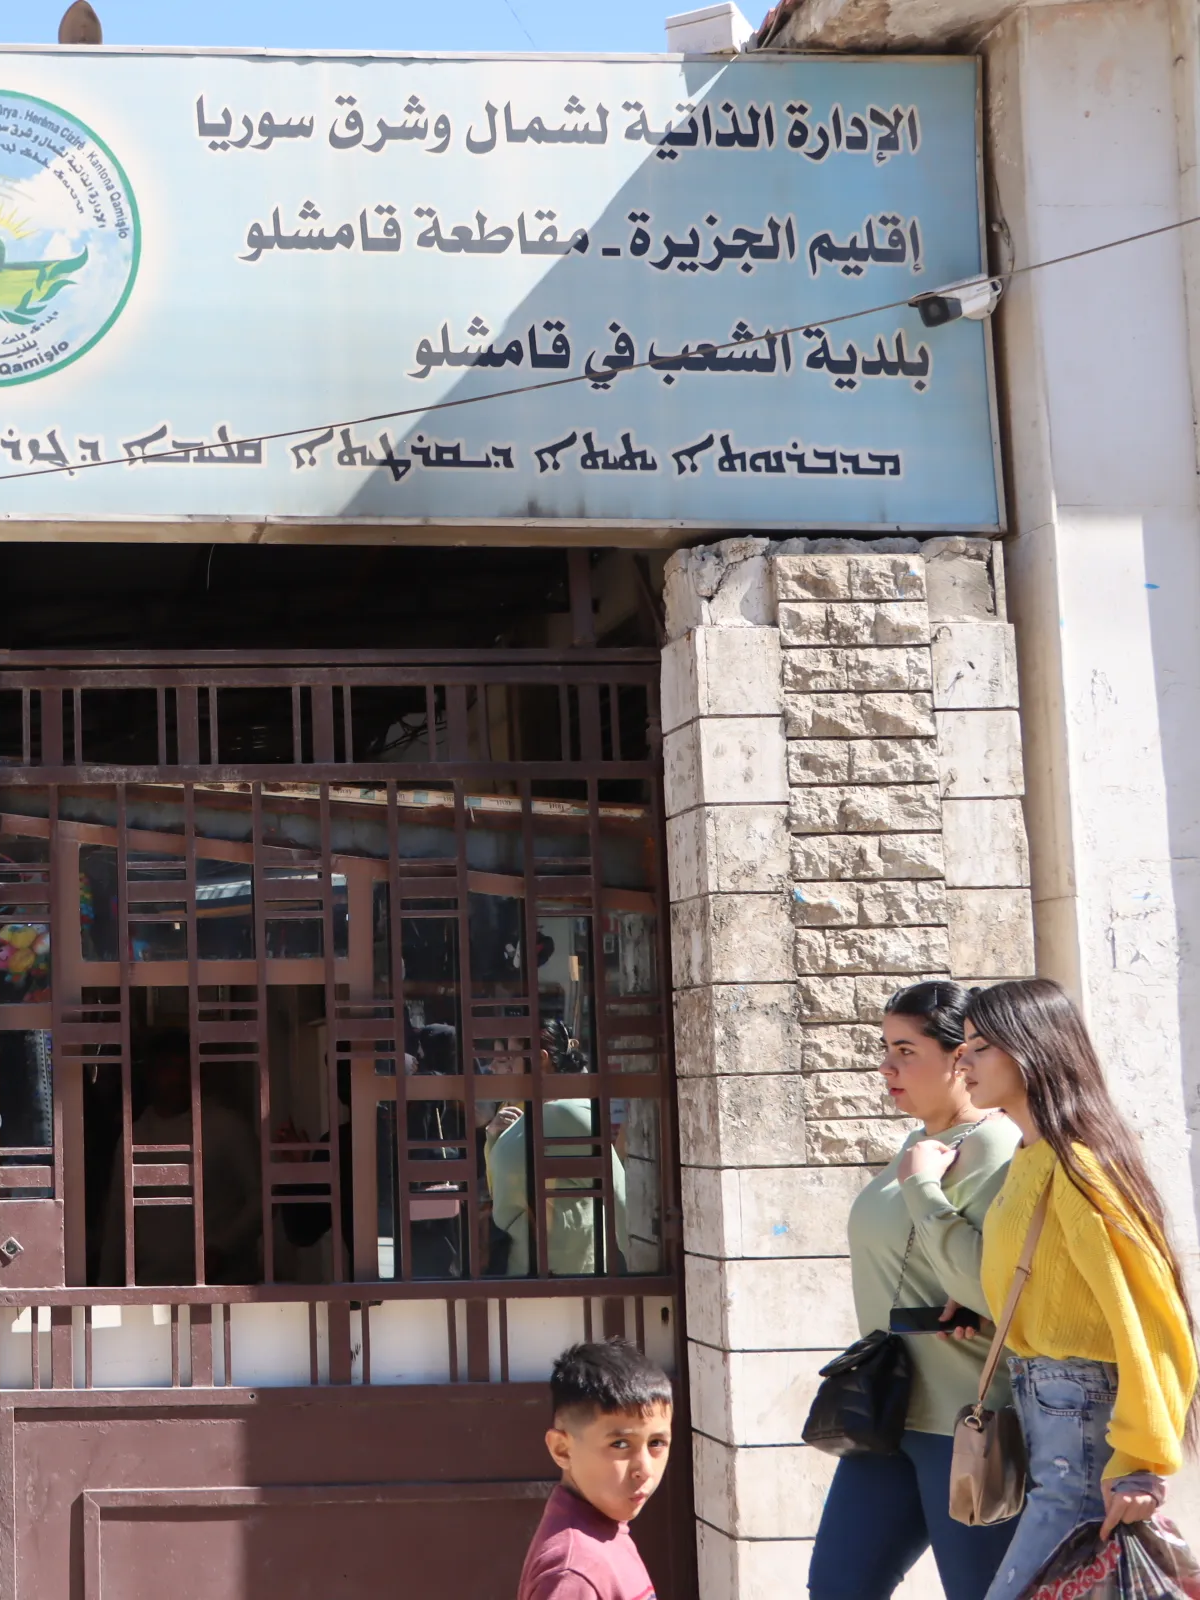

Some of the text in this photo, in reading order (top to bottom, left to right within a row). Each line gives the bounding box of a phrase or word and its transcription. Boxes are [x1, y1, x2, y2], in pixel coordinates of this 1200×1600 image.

[197, 95, 917, 161] الإدارة الذاتية لشمال وشرق سوريا
[87, 151, 115, 191] Kantona
[239, 201, 401, 261] قامشلو
[415, 208, 588, 258] مقاطعة
[628, 212, 795, 273] الجزيرة
[809, 216, 921, 275] إقليم
[407, 317, 931, 391] بلدية الشعب في قامشلو
